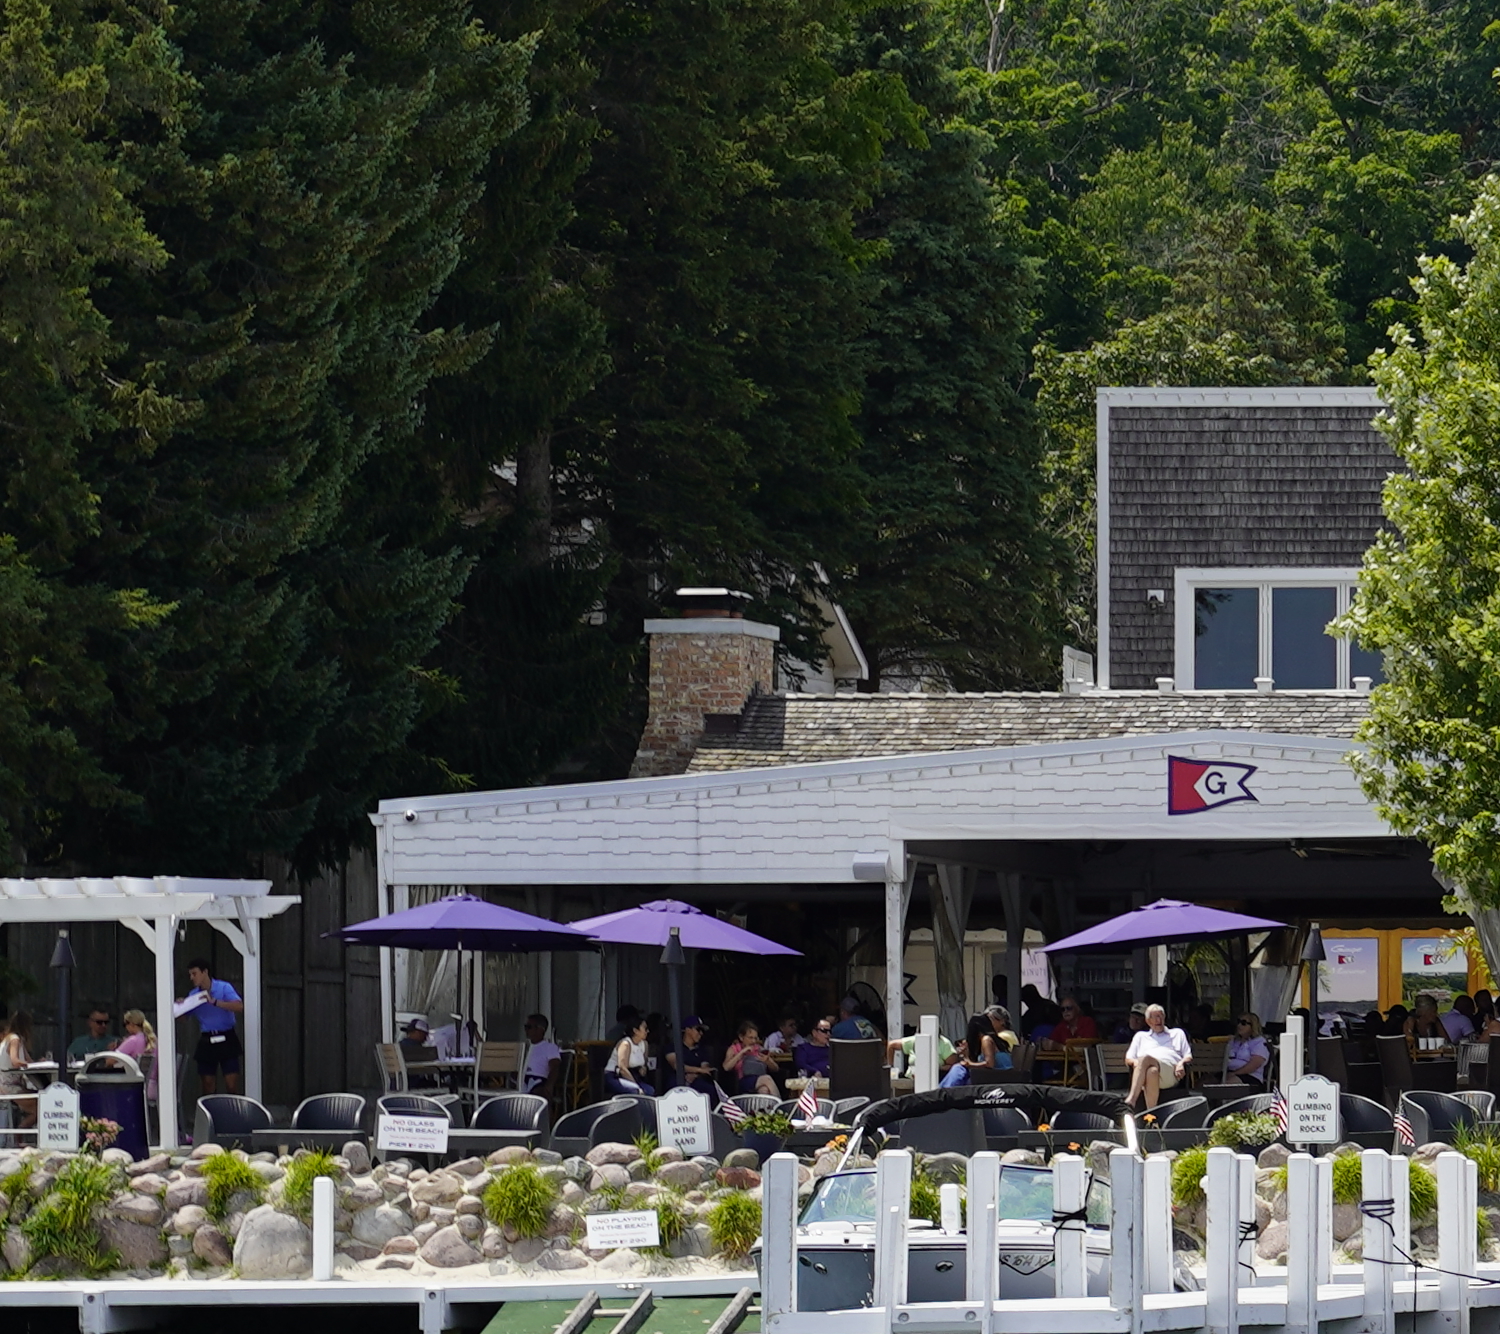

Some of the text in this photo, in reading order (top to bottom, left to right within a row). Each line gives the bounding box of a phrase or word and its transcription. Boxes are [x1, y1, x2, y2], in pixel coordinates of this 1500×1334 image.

[1205, 771, 1227, 795] G
[1307, 1092, 1319, 1100] NO
[54, 1100, 64, 1108] NO
[1293, 1103, 1332, 1111] CLIMBING
[677, 1104, 688, 1113] NO
[43, 1111, 74, 1119] CLIMBING
[667, 1114, 700, 1124] PLAYING
[1299, 1114, 1327, 1122] ON THE
[47, 1122, 69, 1130] ON THE
[1299, 1125, 1326, 1133] ROCKS
[672, 1126, 697, 1135] IN THE
[47, 1133, 69, 1141] ROCKS
[674, 1137, 696, 1146] SAND
